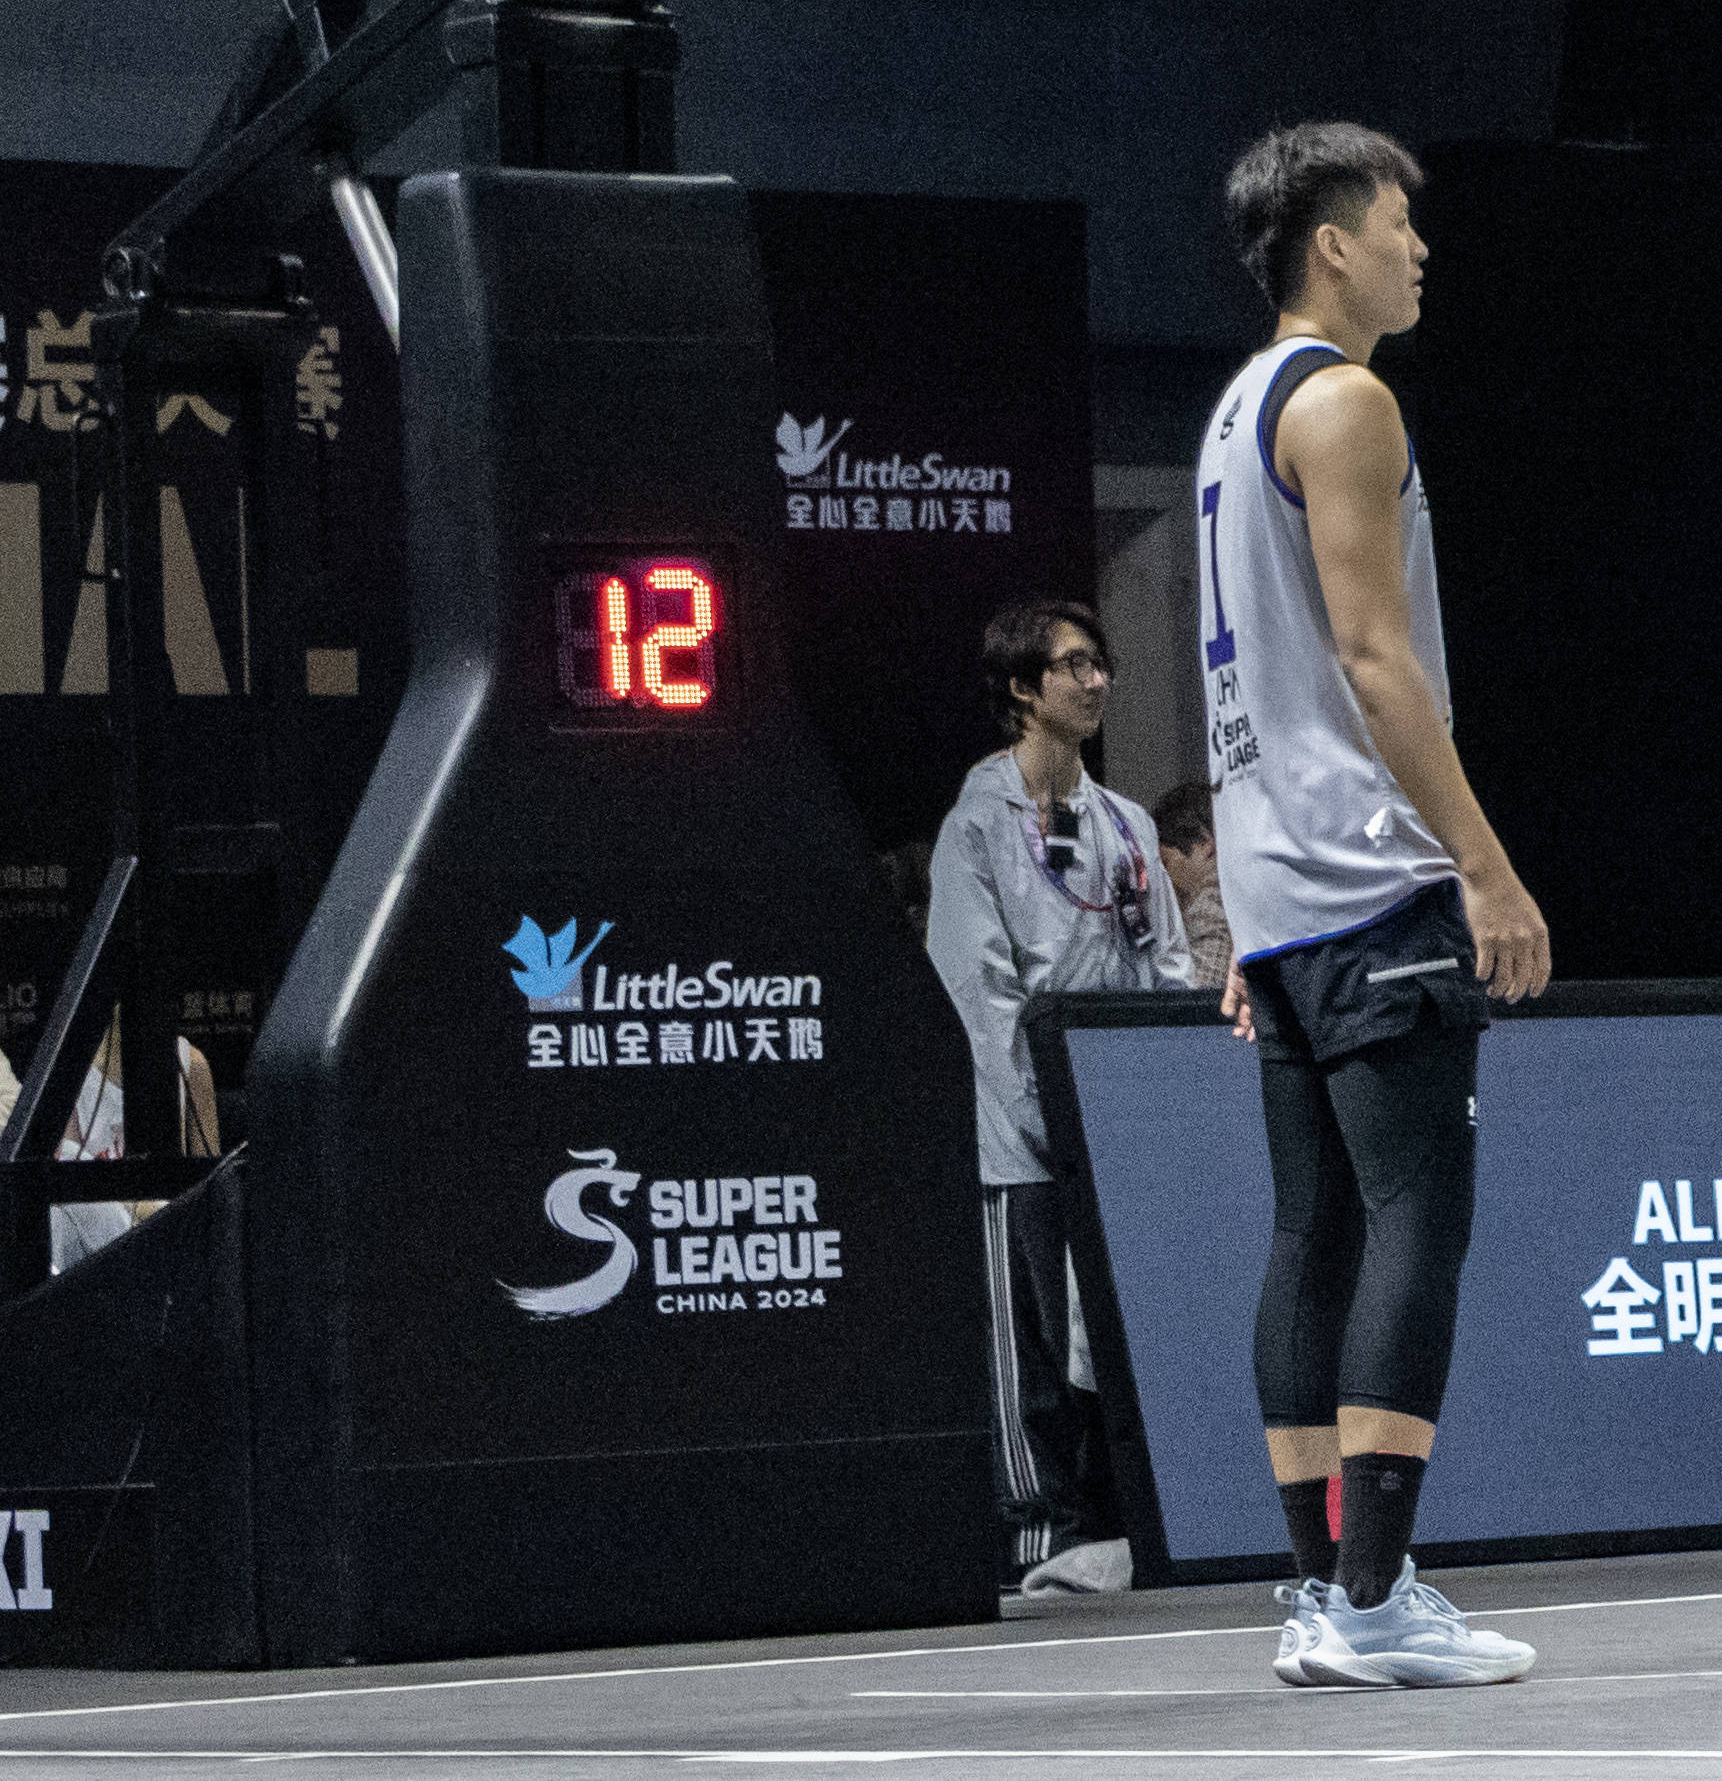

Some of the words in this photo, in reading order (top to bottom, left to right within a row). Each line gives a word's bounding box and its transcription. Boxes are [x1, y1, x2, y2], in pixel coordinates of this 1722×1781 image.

[836, 452, 1011, 494] LittleSwan
[606, 568, 713, 705] 12
[592, 960, 823, 1012] LittleSwan
[527, 1017, 824, 1069] 全心全意小天鹅
[648, 1174, 819, 1229] SUPER
[652, 1229, 844, 1287] LEAGUE
[655, 1292, 747, 1315] CHINA
[756, 1287, 828, 1311] 2024
